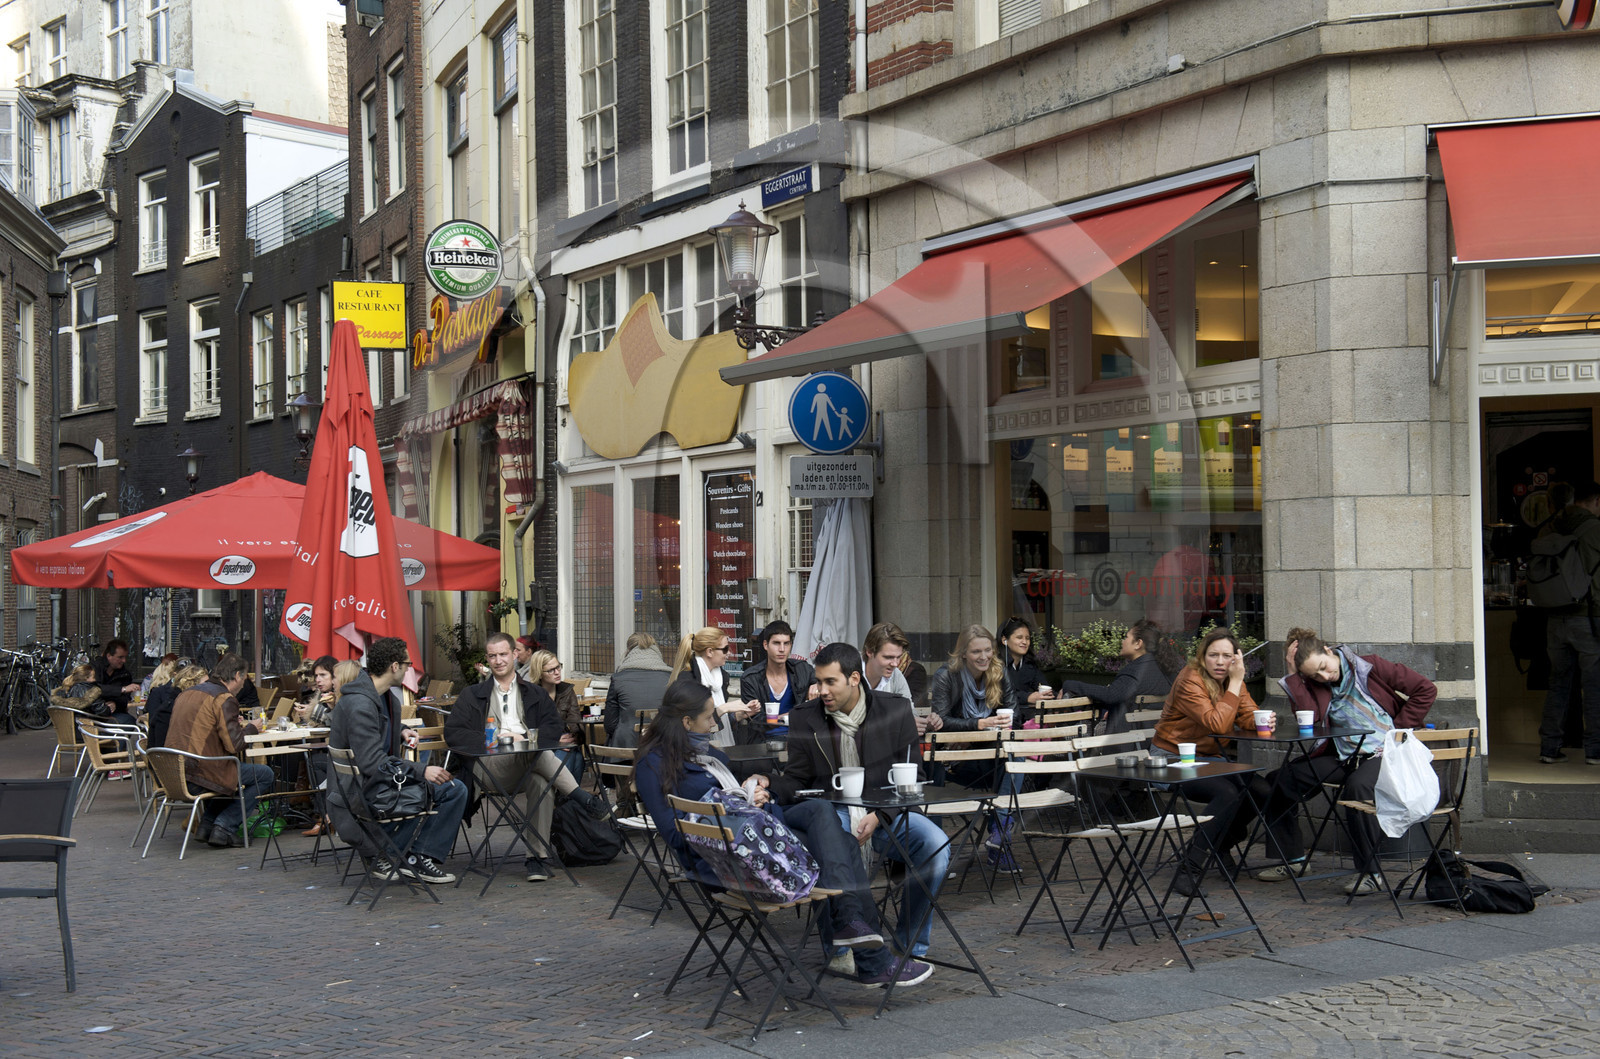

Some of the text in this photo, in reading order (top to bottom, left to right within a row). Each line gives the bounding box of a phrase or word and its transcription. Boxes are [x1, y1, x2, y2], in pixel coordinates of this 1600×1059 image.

[765, 170, 806, 195] EGGERTSTRAAT
[789, 183, 808, 195] CENTRUM
[438, 227, 490, 245] HEINEKEN PILSENER
[434, 251, 496, 266] Heineken
[438, 272, 491, 291] PREMIUM QUALITY
[356, 289, 382, 298] CAFE
[337, 301, 402, 312] RESTAURANT
[355, 324, 404, 344] Passage
[413, 288, 499, 368] De Passage
[806, 461, 857, 473] uitgezonderd
[802, 473, 824, 482] laden
[836, 473, 862, 482] lossen
[707, 485, 734, 496] Souvenirs
[737, 483, 752, 493] Gifts
[794, 483, 817, 491] ma.t/m
[829, 482, 870, 491] 07.00-11.00h
[719, 507, 739, 515] Postcards
[726, 535, 739, 543] Shirts
[713, 550, 726, 558] Dutch
[212, 558, 253, 577] Segafredo
[722, 564, 738, 572] Patches
[721, 578, 739, 587] Magnets
[1026, 569, 1236, 609] Coffee Company
